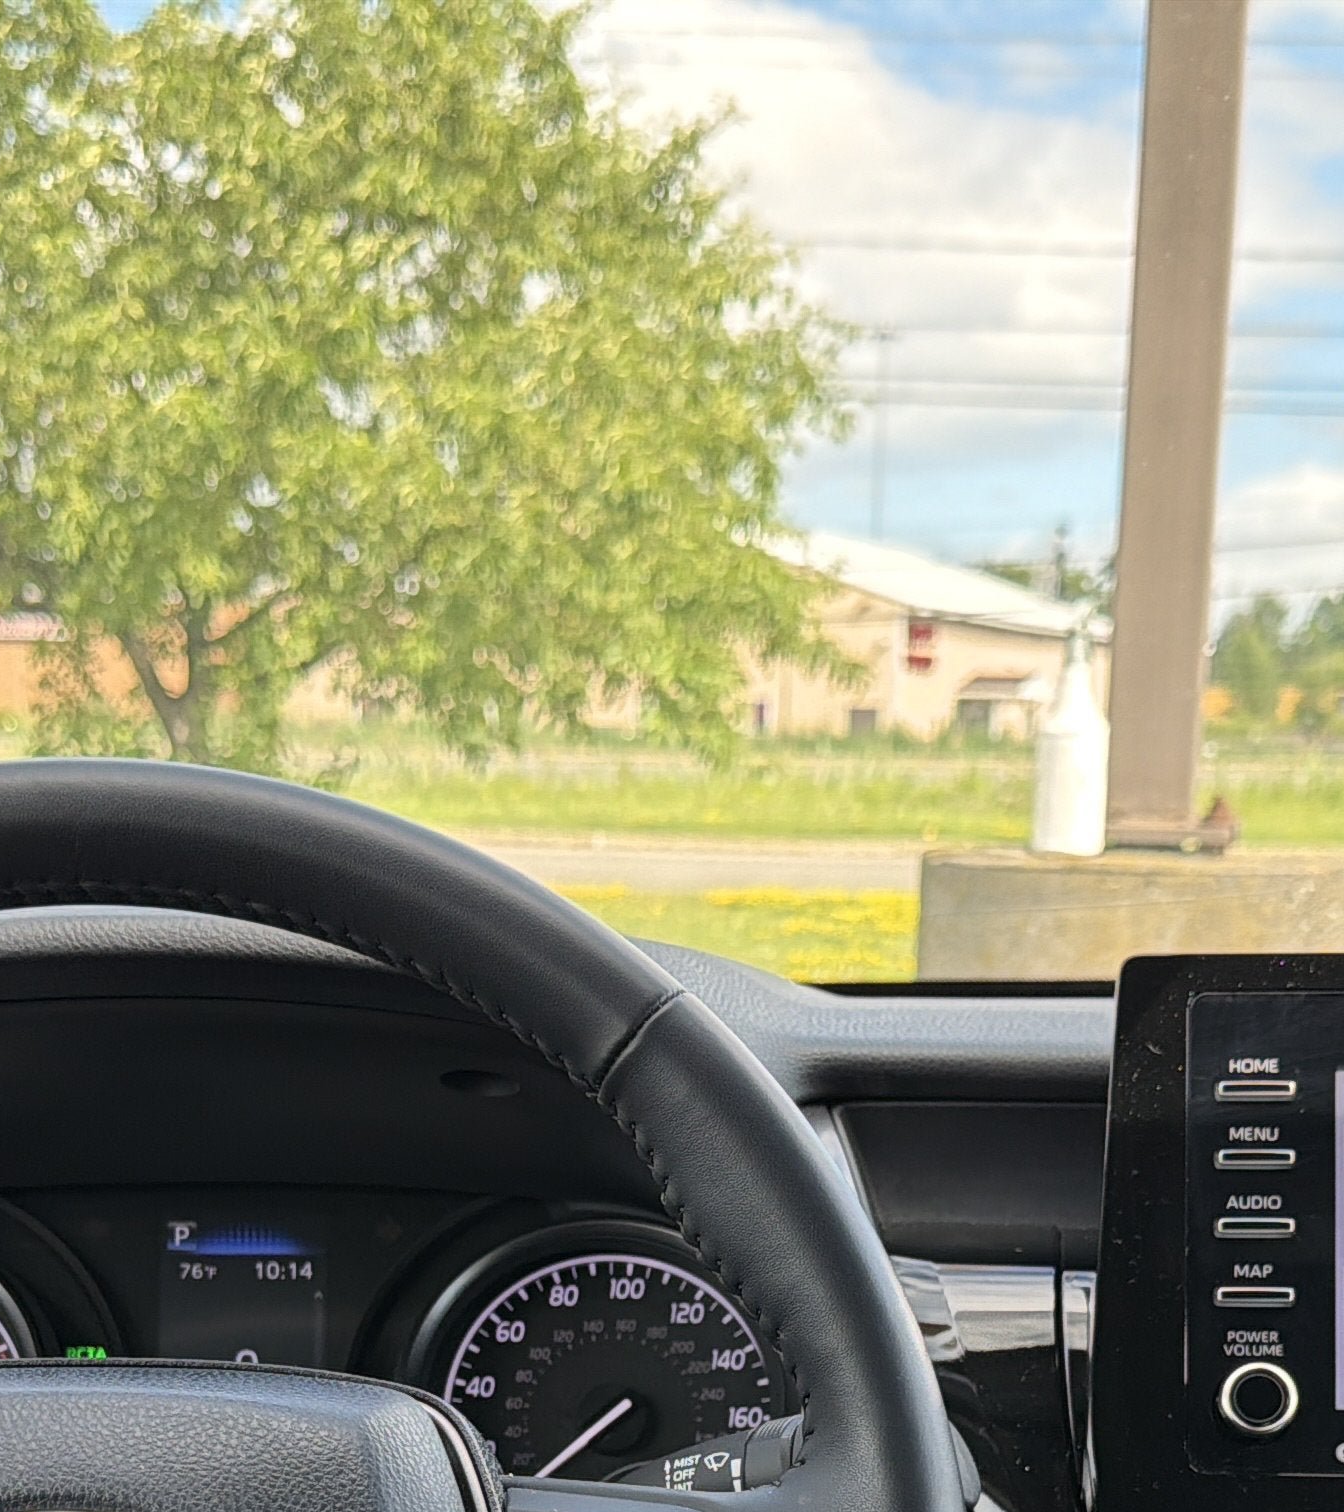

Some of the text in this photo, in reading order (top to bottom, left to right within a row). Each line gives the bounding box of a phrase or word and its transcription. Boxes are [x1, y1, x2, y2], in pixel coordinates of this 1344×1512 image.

[1229, 1058, 1279, 1074] HOME
[1229, 1126, 1279, 1142] MENU
[1226, 1195, 1282, 1210] AUDIO
[174, 1226, 190, 1246] P
[255, 1261, 313, 1280] 10:14
[1233, 1264, 1273, 1279] MAP
[549, 1285, 579, 1307] 80
[609, 1278, 645, 1301] 100
[670, 1302, 705, 1325] 120
[495, 1320, 526, 1343] 60
[1227, 1331, 1279, 1344] POWER
[1223, 1344, 1284, 1357] VOLUME
[711, 1349, 746, 1371] 140
[465, 1376, 496, 1398] 40
[728, 1407, 763, 1429] 160
[673, 1454, 702, 1469] MIST
[673, 1468, 696, 1482] OFF
[674, 1481, 694, 1491] INT
